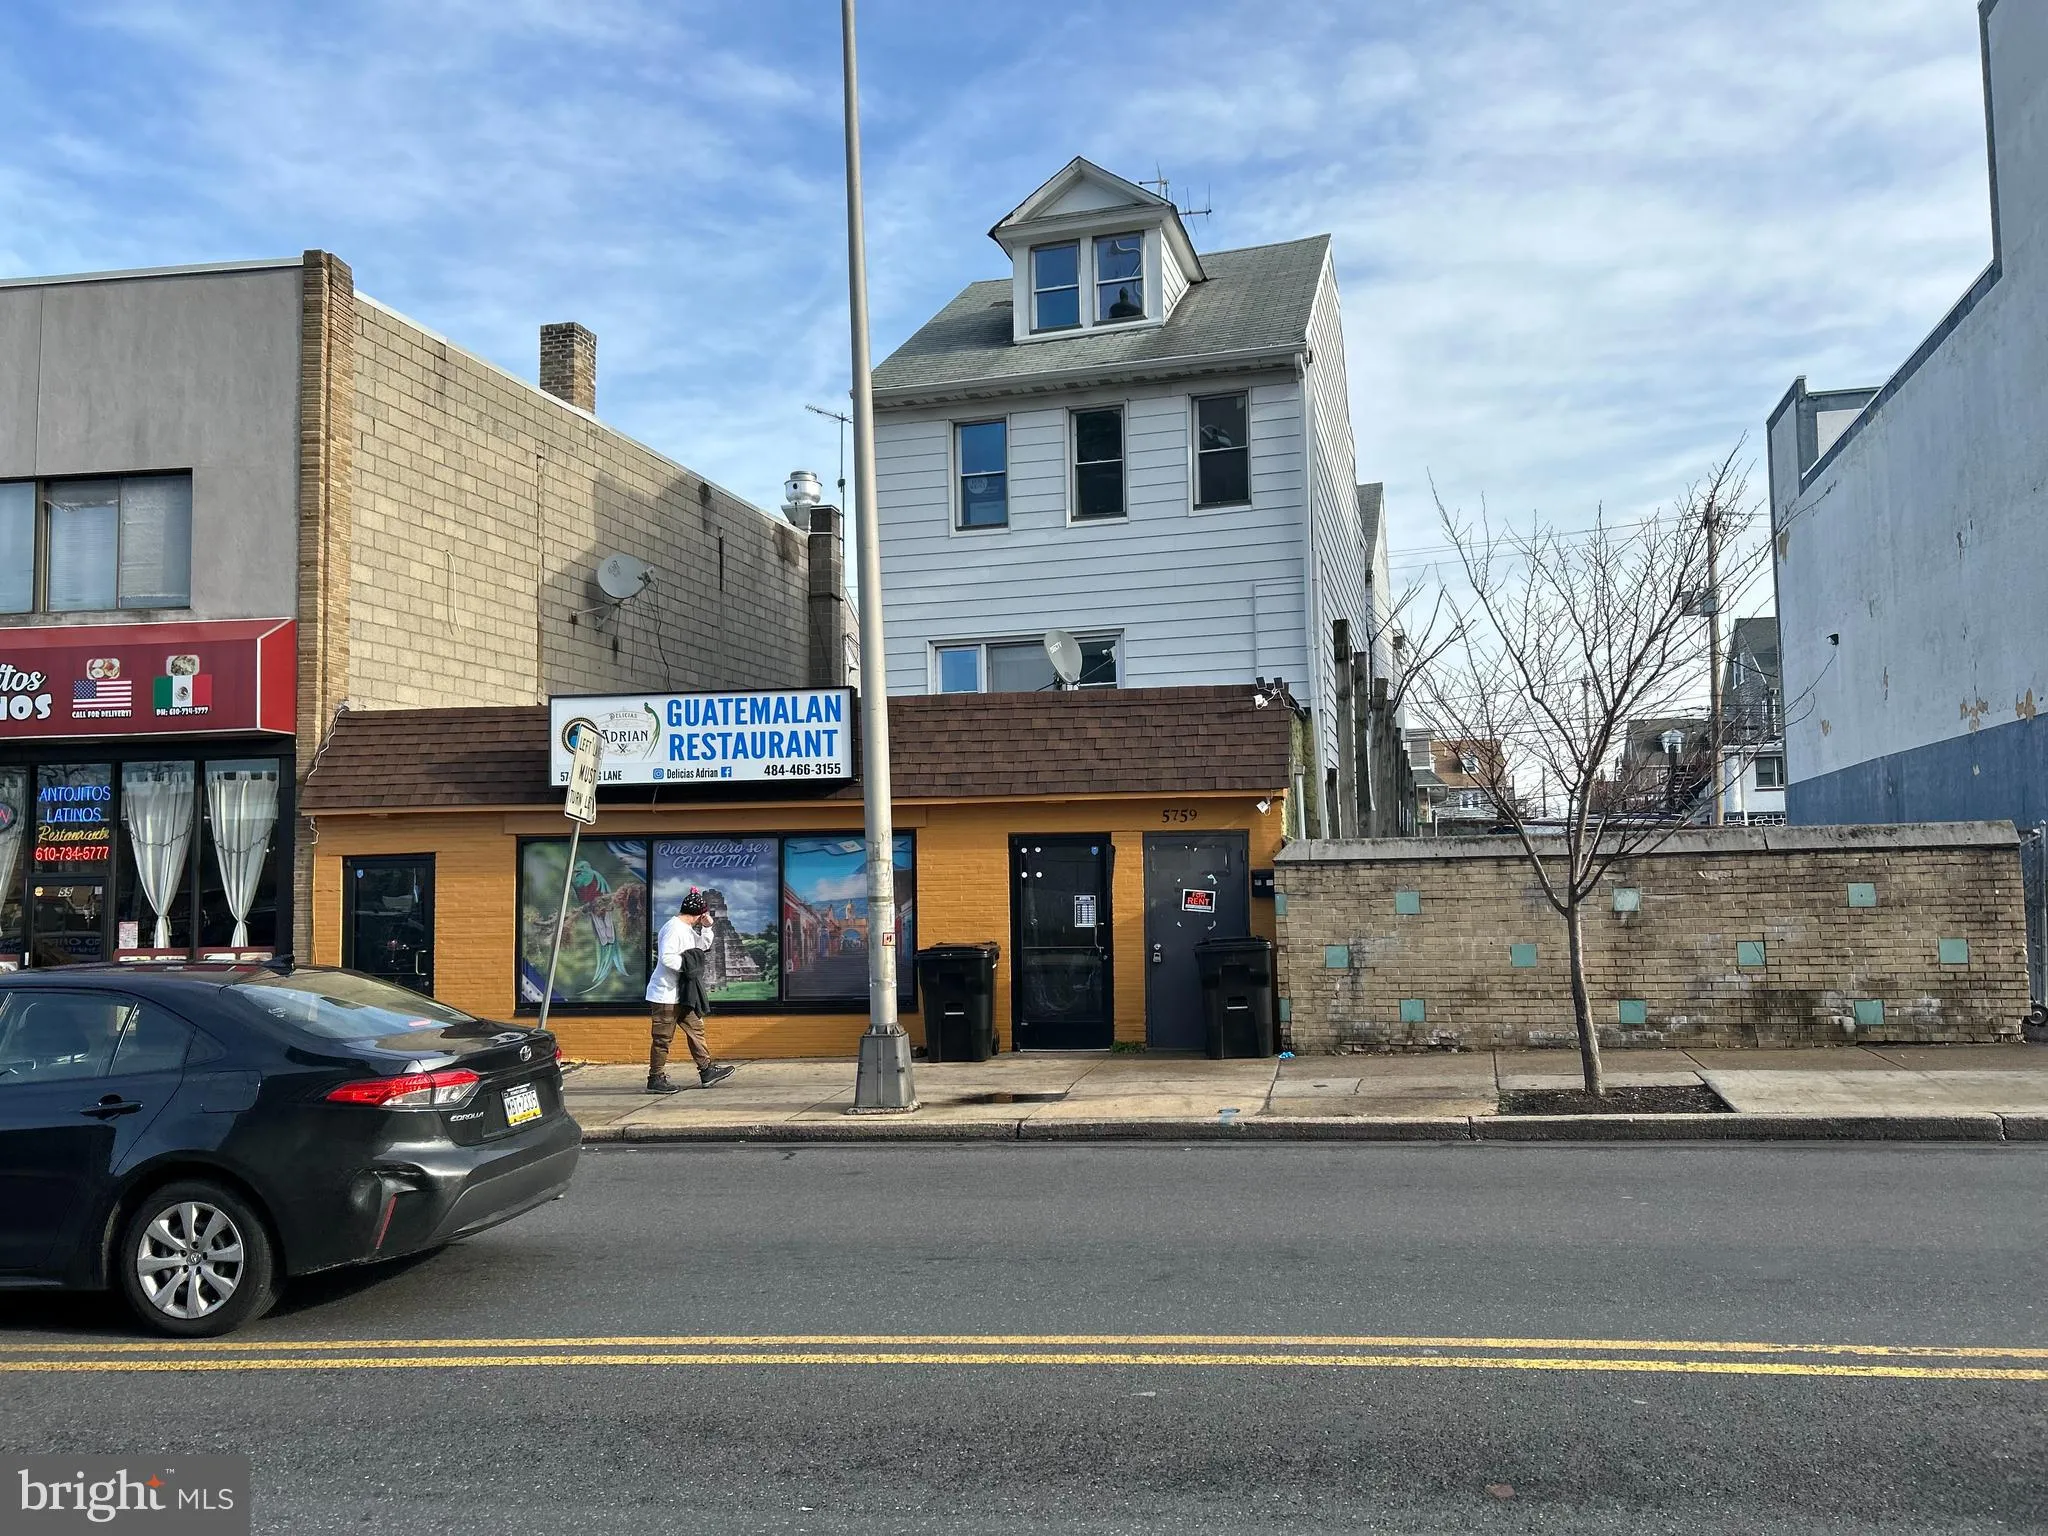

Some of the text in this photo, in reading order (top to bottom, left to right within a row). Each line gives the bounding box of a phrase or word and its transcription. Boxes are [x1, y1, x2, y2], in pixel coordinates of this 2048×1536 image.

[88, 710, 99, 718] FOR
[609, 712, 637, 720] DELICIAS
[667, 695, 841, 727] GUATEMALAN
[602, 730, 648, 744] ADRIAN
[669, 729, 838, 761] RESTAURANT
[579, 763, 597, 784] MUST
[604, 770, 622, 781] LANE
[667, 767, 718, 779] Delicias Adrian
[764, 763, 841, 776] 484-466-3155
[39, 785, 111, 802] ANTOJITOS
[46, 807, 102, 823] LATINOS
[1161, 808, 1198, 823] 5759
[35, 846, 109, 861] 610-734-5777
[658, 841, 770, 857] Que chilero ser
[672, 854, 756, 869] CHAPIN!
[1187, 897, 1210, 905] RENT
[450, 1111, 484, 1122] COROLLA
